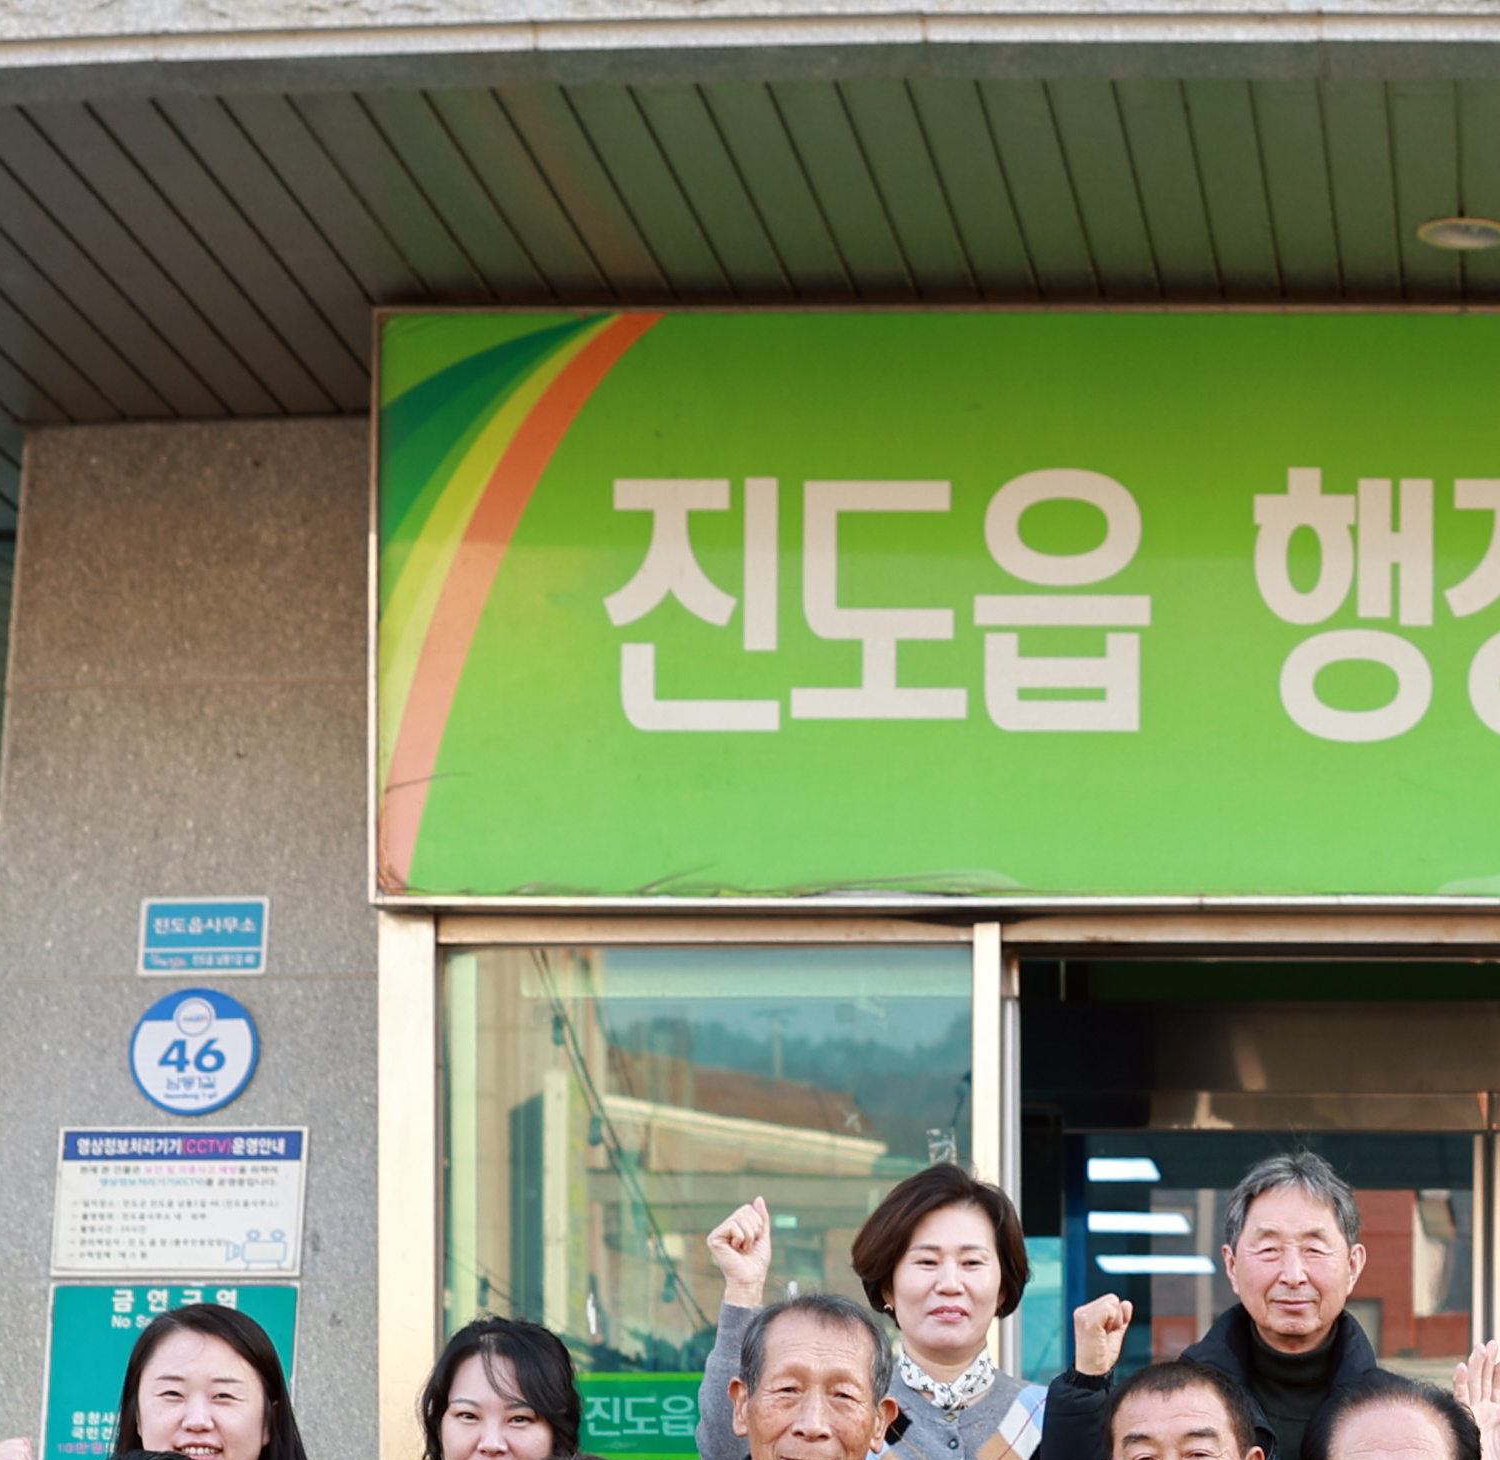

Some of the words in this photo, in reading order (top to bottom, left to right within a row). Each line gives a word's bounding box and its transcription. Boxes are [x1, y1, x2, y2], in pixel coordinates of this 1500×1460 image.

[605, 468, 1151, 733] 진도읍
[154, 917, 257, 934] 진도읍사무소
[158, 1038, 225, 1073] 46
[111, 1314, 131, 1328] No
[584, 1395, 695, 1436] 진도읍
